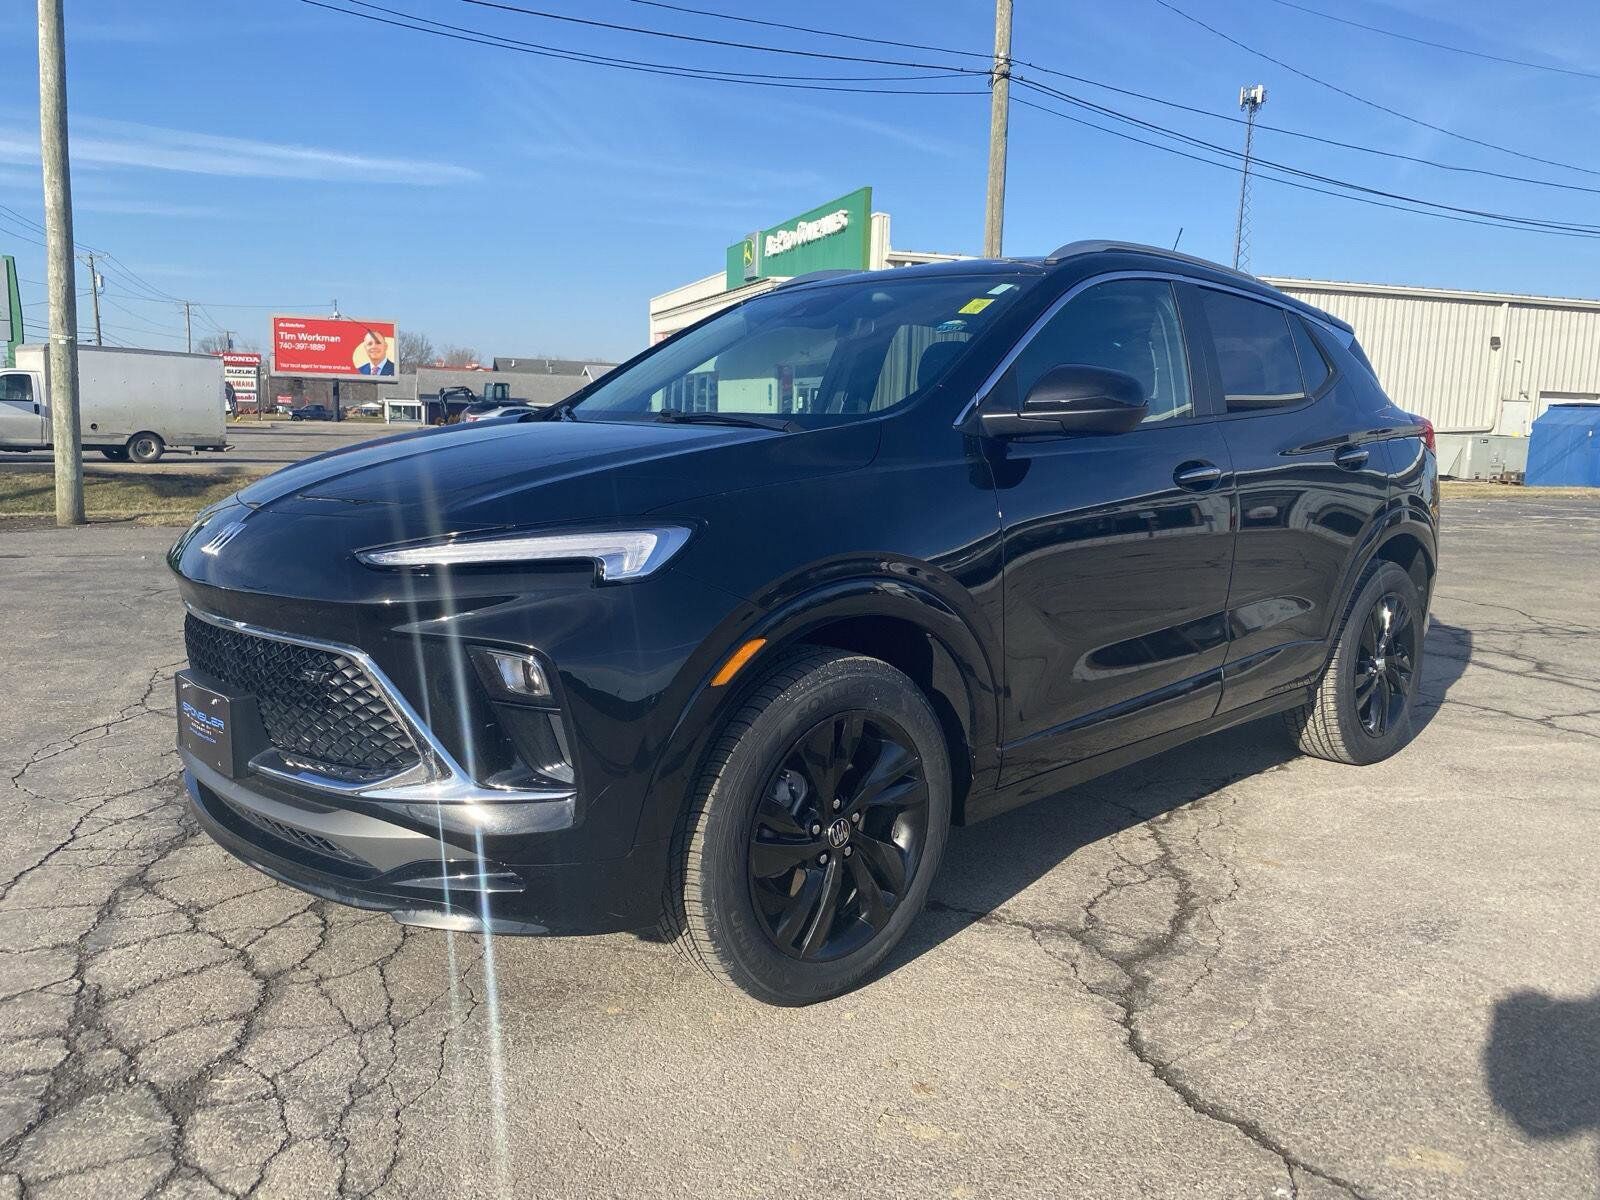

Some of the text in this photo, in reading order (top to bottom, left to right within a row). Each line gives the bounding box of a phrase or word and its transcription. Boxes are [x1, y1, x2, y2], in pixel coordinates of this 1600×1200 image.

[279, 331, 341, 343] Tim Workman
[223, 355, 260, 363] HONDA
